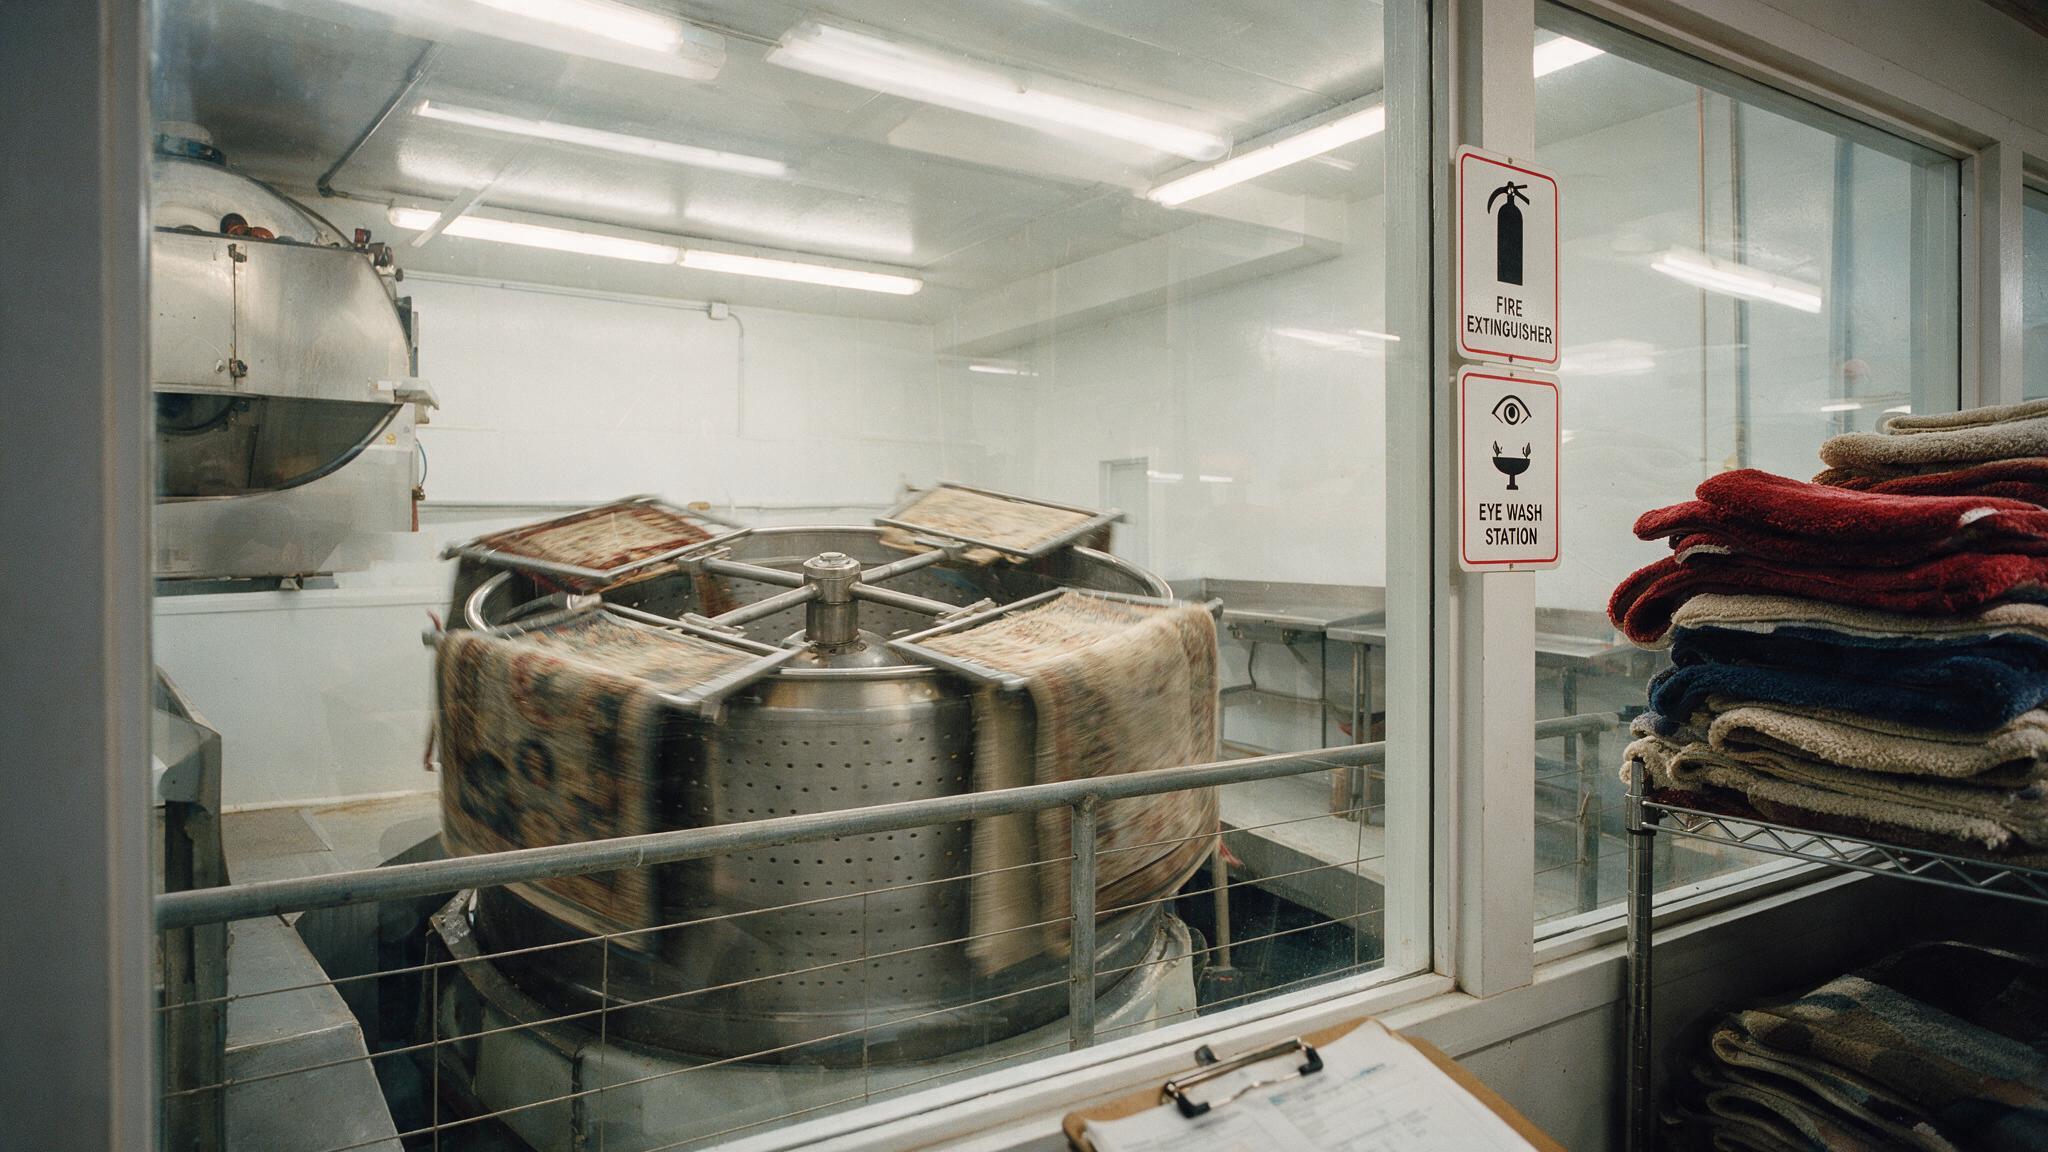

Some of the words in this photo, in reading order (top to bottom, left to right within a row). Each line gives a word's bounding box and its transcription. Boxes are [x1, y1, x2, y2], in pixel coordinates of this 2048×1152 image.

[1496, 296, 1523, 317] FIRE
[1467, 315, 1553, 344] EXTINGUISHER
[1479, 503, 1503, 521] EYE
[1506, 503, 1543, 522] WASH
[1485, 527, 1538, 545] STATION
